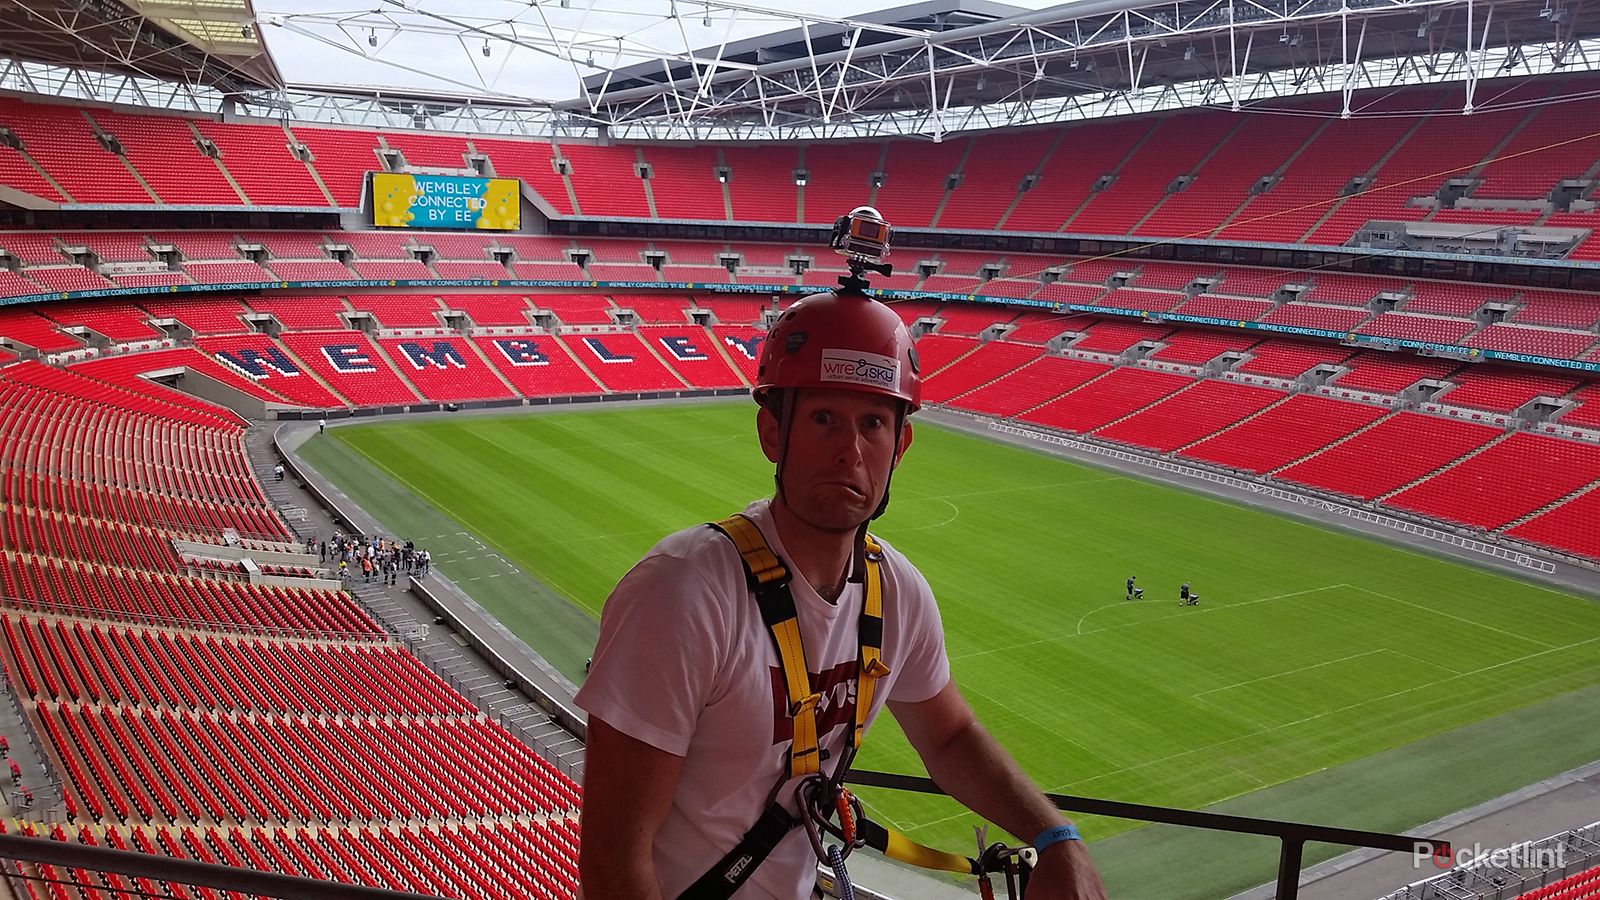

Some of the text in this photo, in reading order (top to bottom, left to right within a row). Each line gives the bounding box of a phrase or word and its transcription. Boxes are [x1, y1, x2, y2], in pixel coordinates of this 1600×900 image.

[414, 181, 481, 194] WEMBLEY
[408, 195, 487, 209] CONNECTED
[429, 209, 472, 222] BY EE
[221, 282, 259, 290] CONNECTED
[80, 289, 110, 298] WEMBLEY
[111, 287, 148, 296] CONNECTED
[150, 286, 159, 294] BY
[894, 290, 920, 298] WEMBLEY
[8, 293, 41, 304] CONNECTED
[43, 293, 51, 301] BY
[1009, 298, 1038, 306] CONNECTED
[1070, 304, 1093, 313] WEMBLEY
[1093, 306, 1124, 315] CONNECTED
[1184, 314, 1218, 325] CONNECTED
[1257, 323, 1288, 332] WEMBLEY
[1287, 326, 1325, 337] CONNECTED
[1328, 330, 1337, 338] BY
[1447, 345, 1456, 353] BY
[215, 336, 764, 381] WEMBLEY
[1494, 351, 1597, 371] WEMBLEY CONNECTED BY
[861, 377, 889, 387] adventures
[724, 855, 753, 883] PETZL
